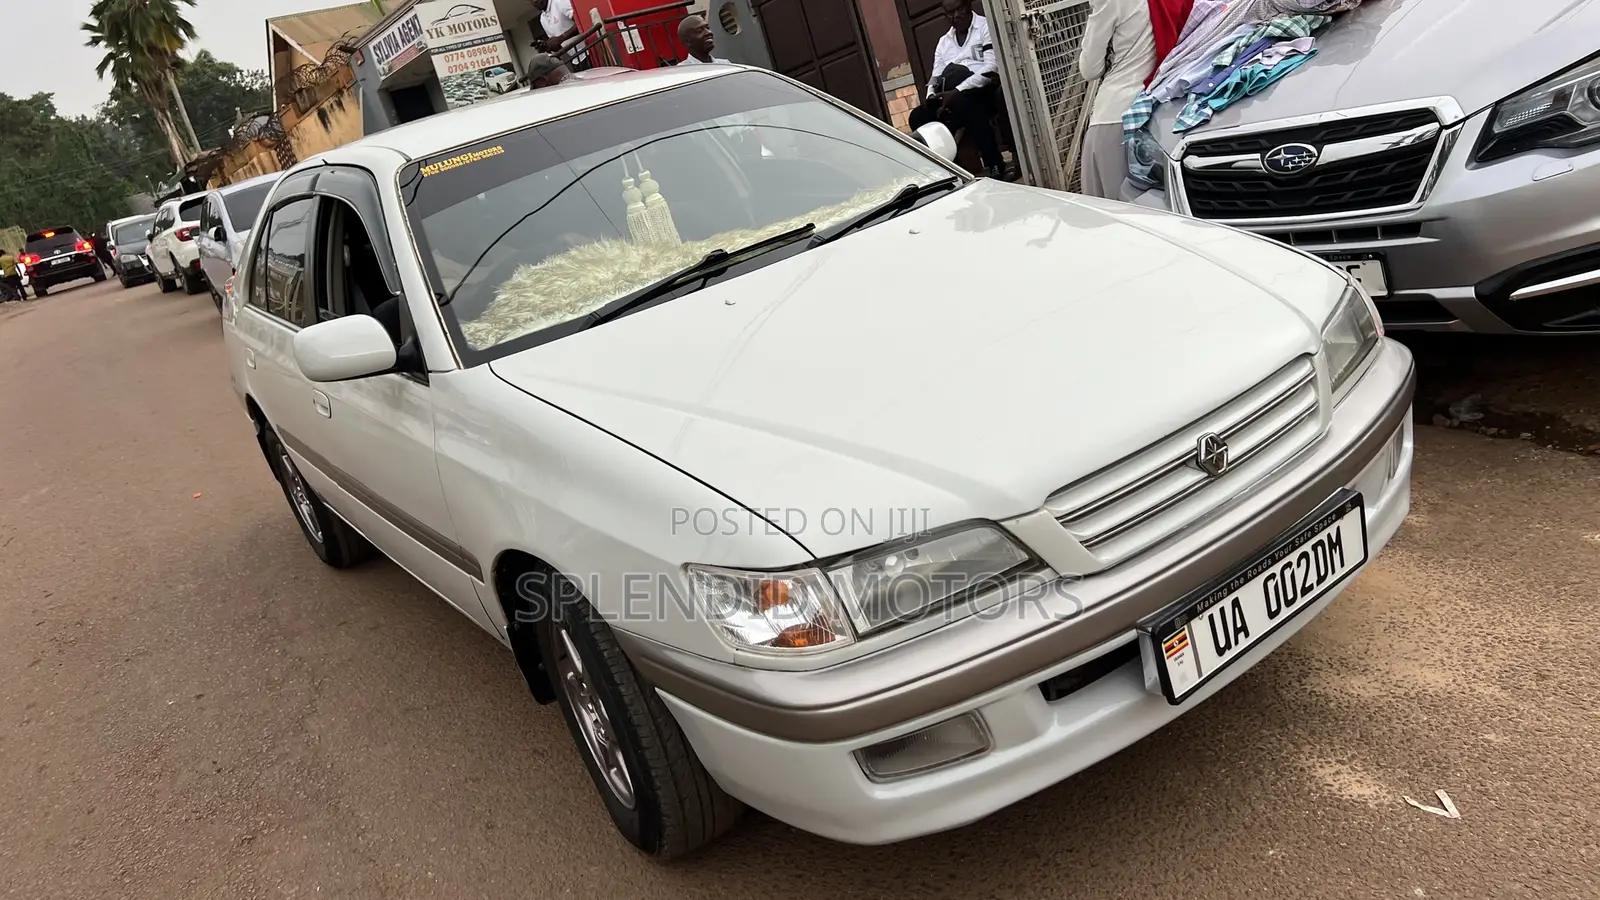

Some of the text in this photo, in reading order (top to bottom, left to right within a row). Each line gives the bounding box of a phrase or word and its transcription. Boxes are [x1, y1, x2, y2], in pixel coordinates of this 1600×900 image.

[425, 26, 445, 39] YK
[447, 15, 498, 36] MOTORS
[444, 44, 498, 63] 0774 089860
[448, 55, 501, 74] 0704 916471
[1196, 513, 1337, 613] Making the Roads Your Safe Space
[1208, 525, 1345, 657] UA 002DM
